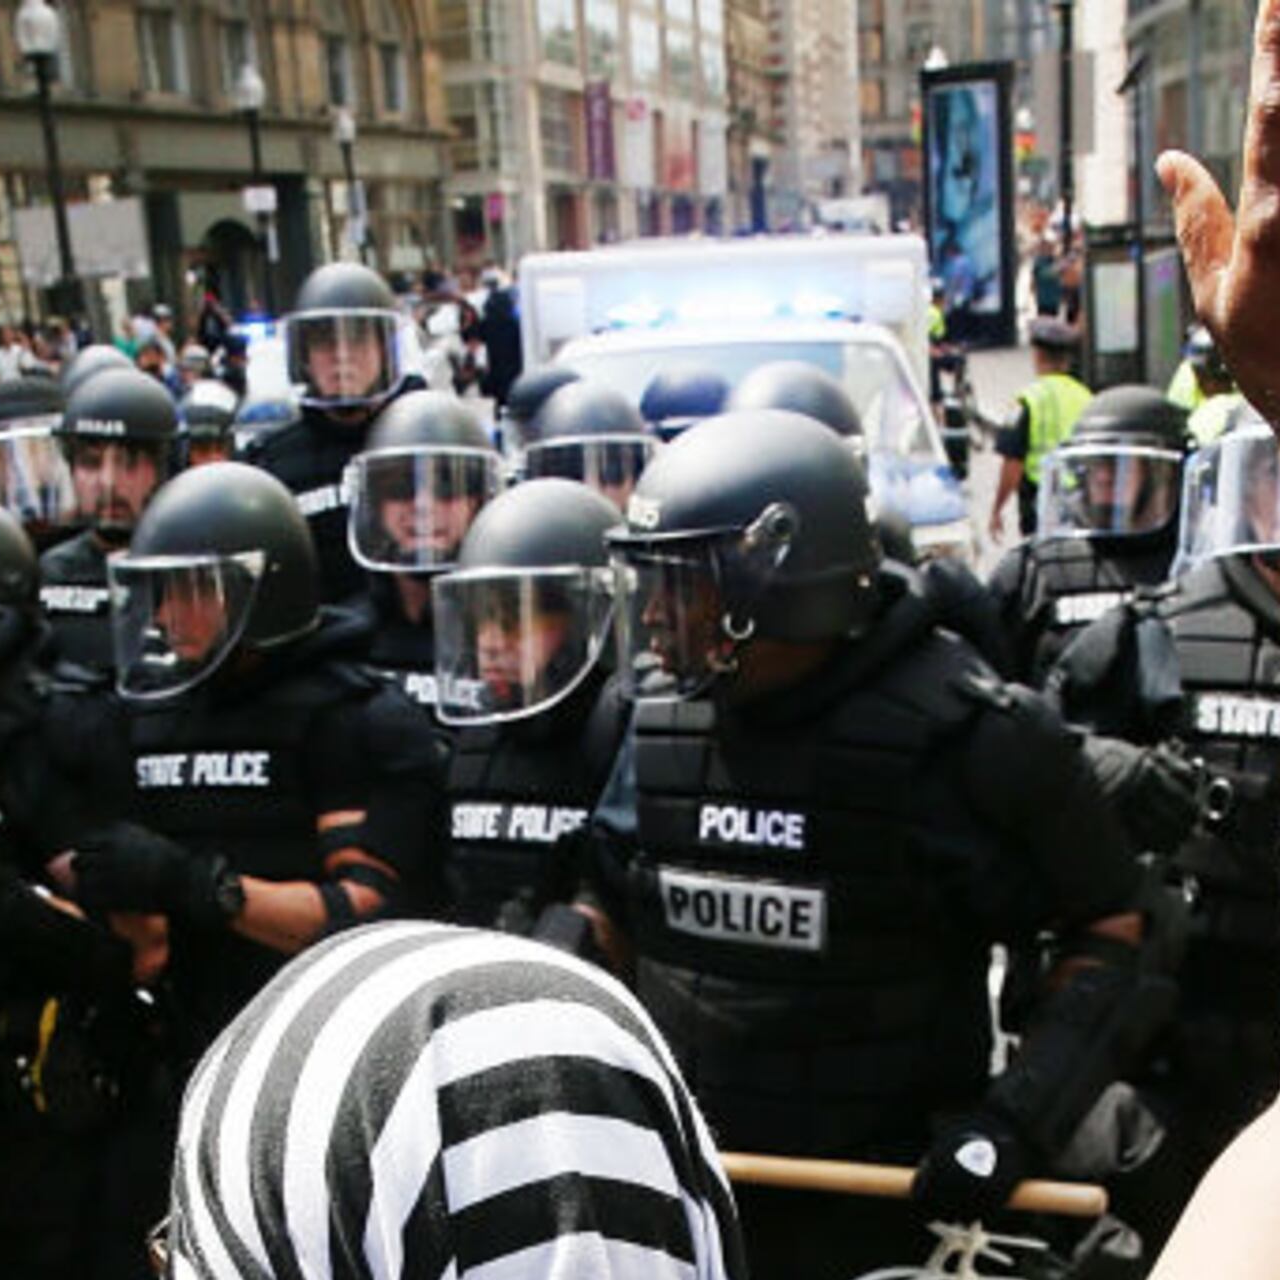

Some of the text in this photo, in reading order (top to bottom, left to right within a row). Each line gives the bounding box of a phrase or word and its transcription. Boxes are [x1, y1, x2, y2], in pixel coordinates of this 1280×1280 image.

[137, 750, 270, 789] STATE POLICE
[452, 802, 502, 839] STATE
[699, 804, 805, 849] POLICE
[669, 884, 813, 940] POLICE
